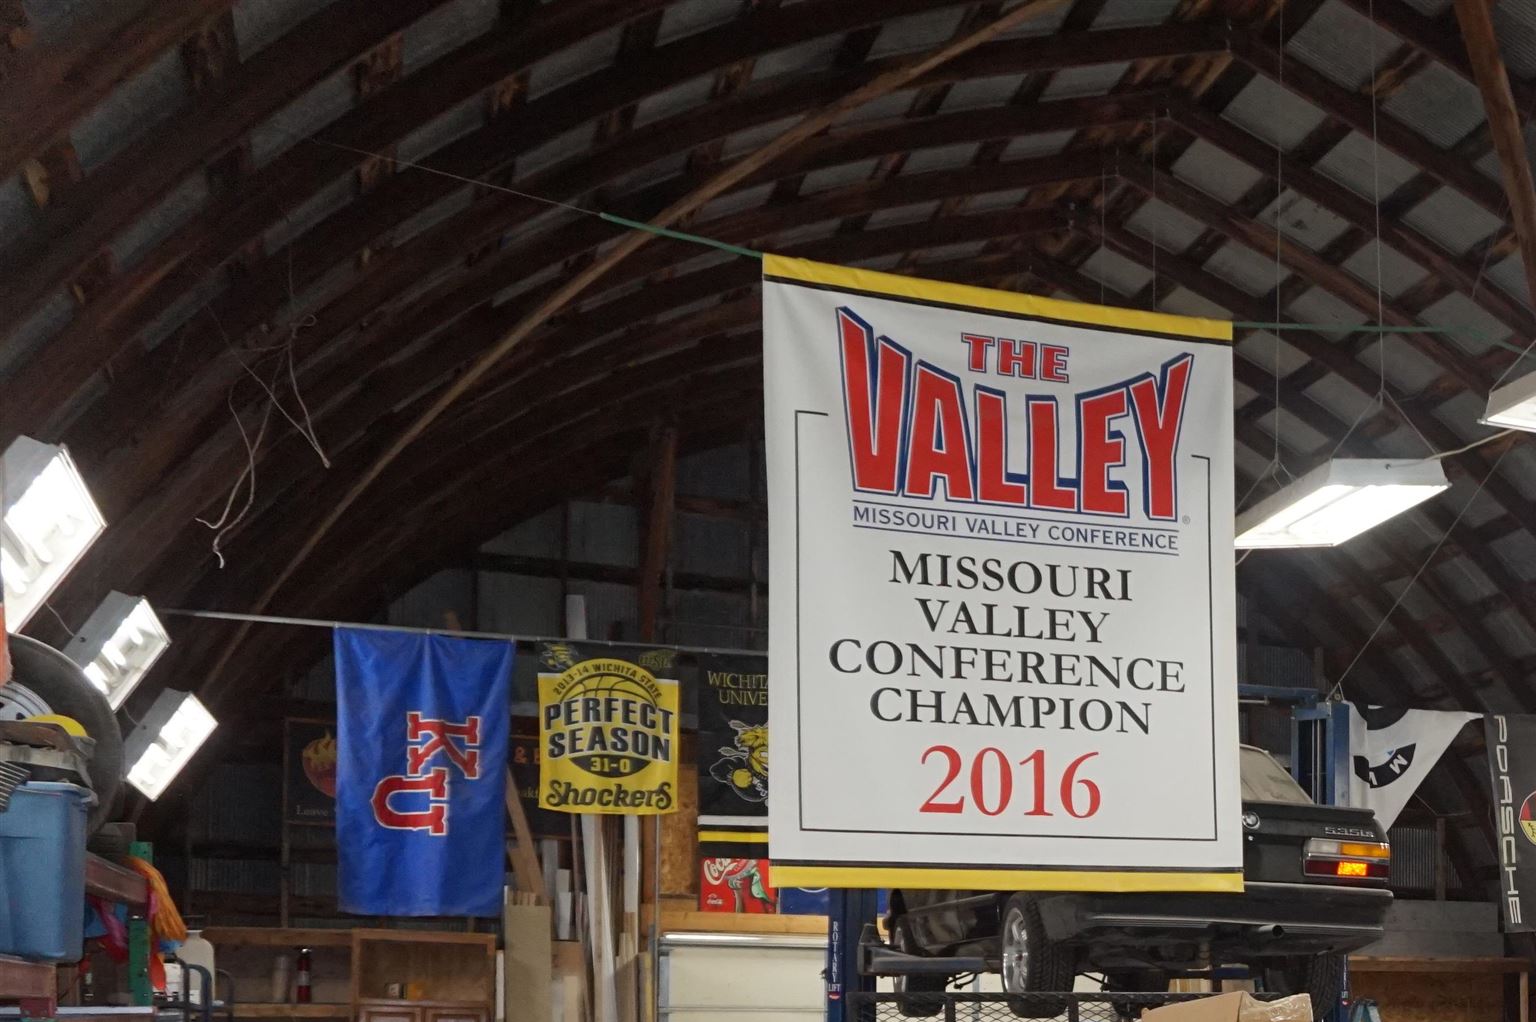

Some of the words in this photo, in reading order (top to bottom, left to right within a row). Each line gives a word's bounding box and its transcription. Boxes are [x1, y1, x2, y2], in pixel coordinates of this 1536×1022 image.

[961, 332, 1069, 383] THE
[836, 306, 1195, 523] VALLEY
[853, 505, 957, 532] MISSOURI
[966, 518, 1040, 539] VALLEY
[1049, 525, 1179, 550] CONFERENCE
[888, 550, 1133, 601] MISSOURI
[914, 598, 1110, 643] VALLEY
[553, 666, 589, 696] 2013-14
[592, 663, 637, 677] WICHITA
[639, 675, 663, 700] STATE
[829, 638, 1186, 693] CONFERENCE
[544, 697, 674, 735] PERFECT
[718, 689, 768, 706] UNIVE
[870, 687, 1152, 735] CHAMPION
[548, 726, 671, 763] SEASON
[589, 757, 631, 772] 31-0
[370, 711, 481, 836] KU
[545, 779, 673, 811] Shockers
[919, 745, 1101, 819] 2016
[1492, 714, 1522, 925] PORSCHE
[831, 920, 840, 983] ROTARY
[828, 984, 841, 993] LIFT
